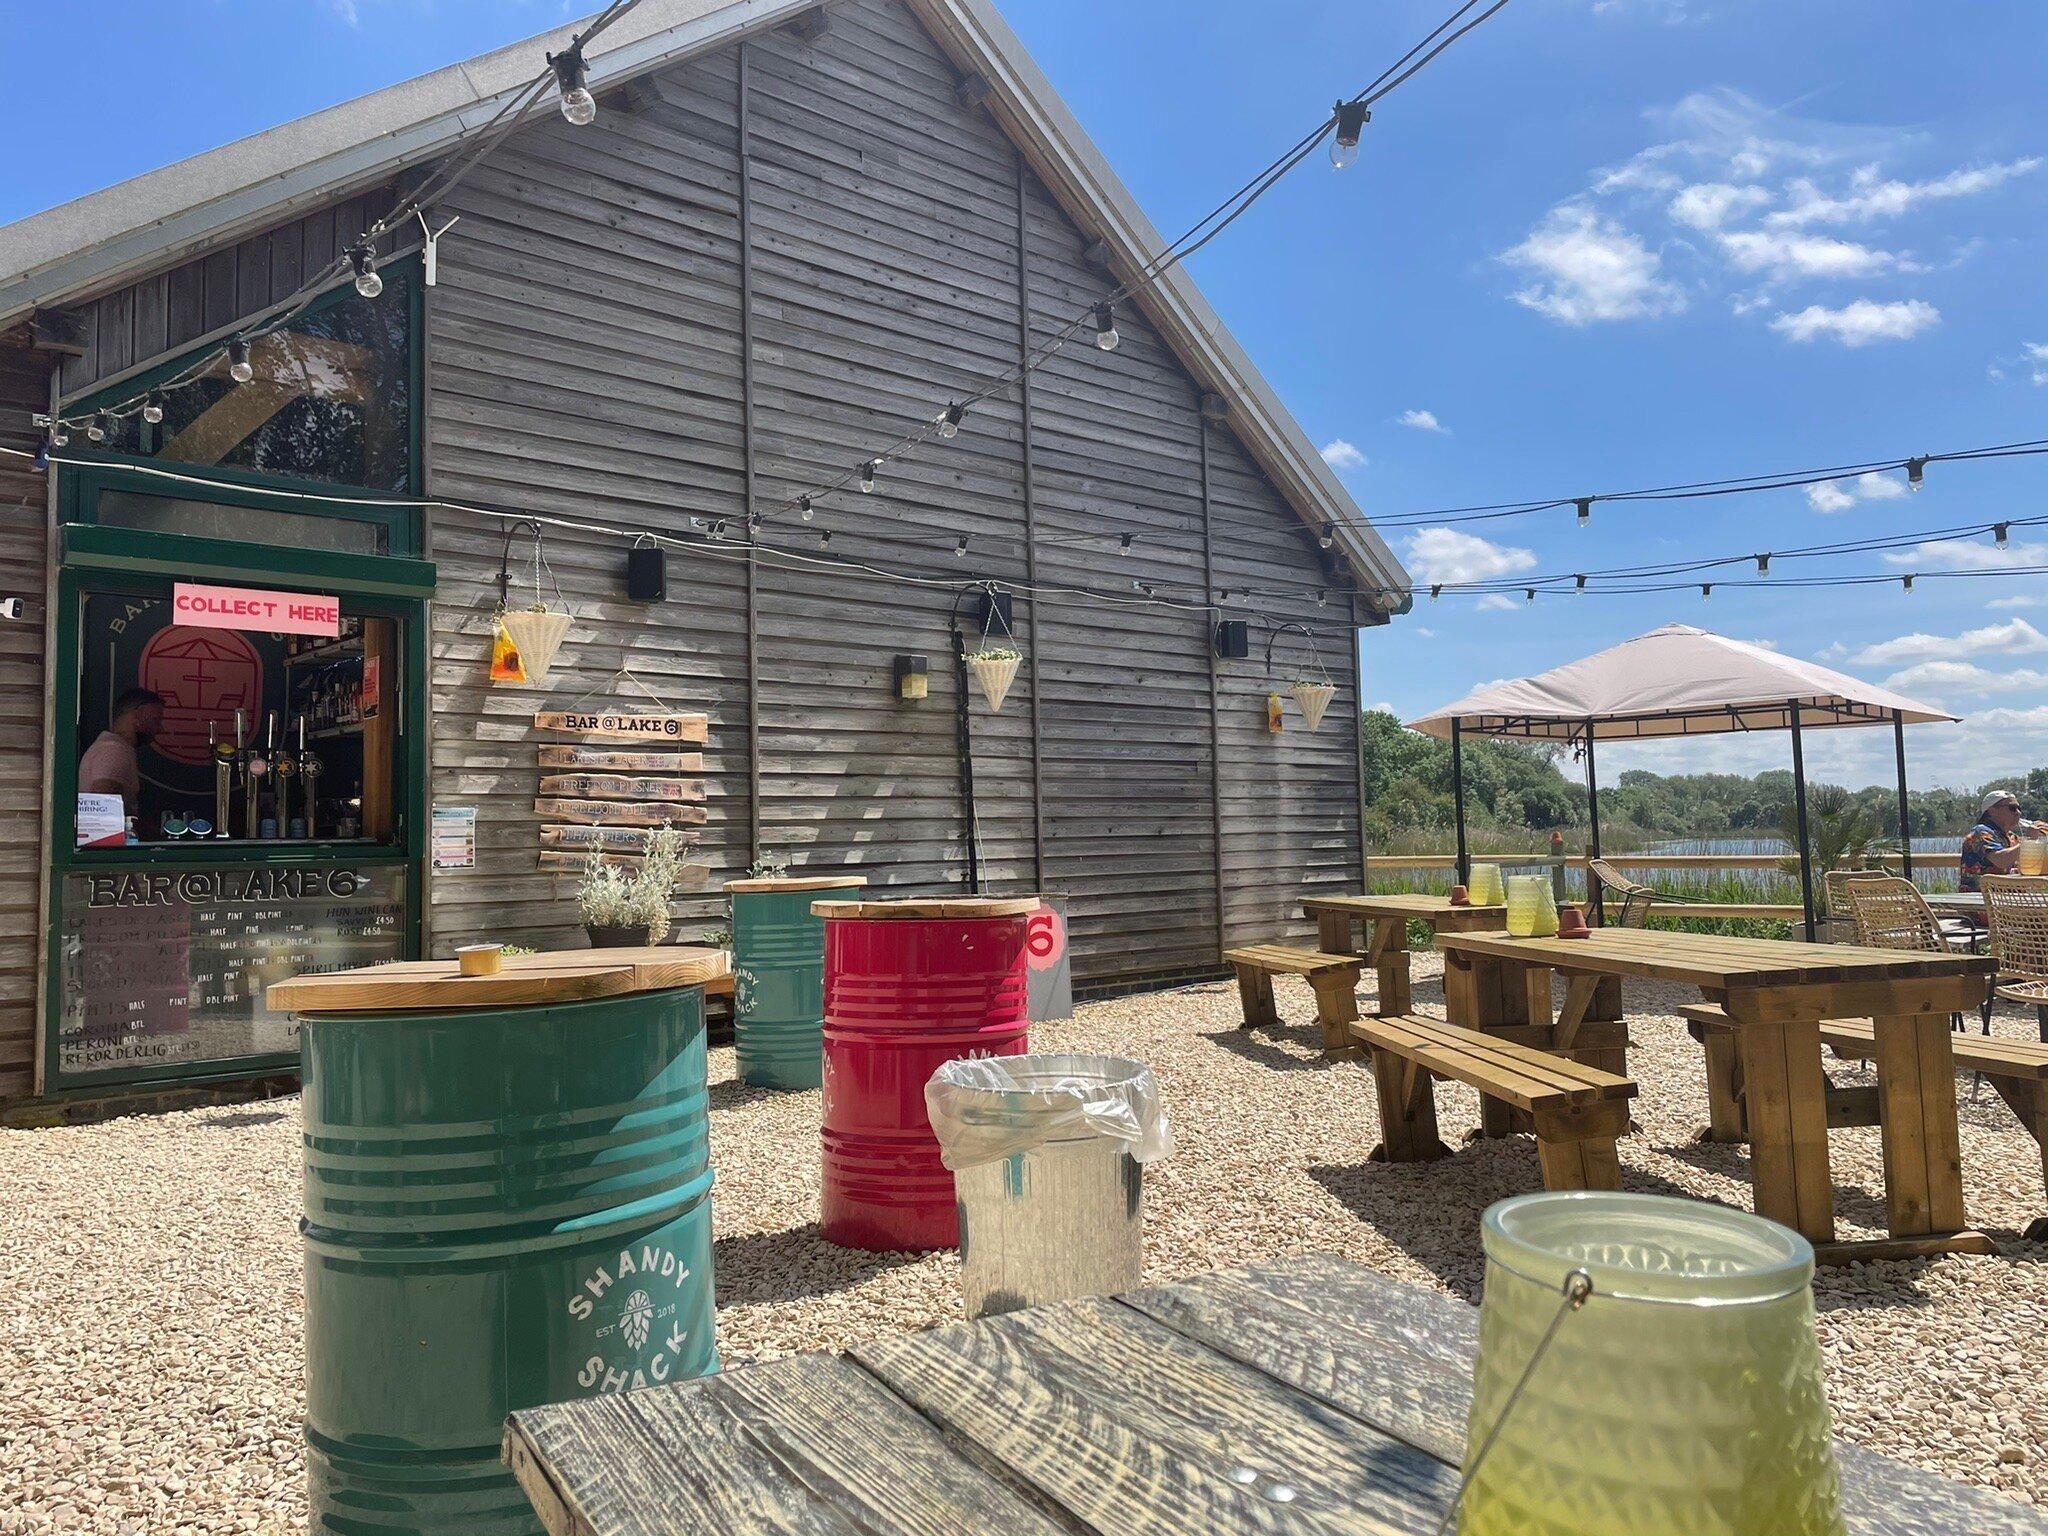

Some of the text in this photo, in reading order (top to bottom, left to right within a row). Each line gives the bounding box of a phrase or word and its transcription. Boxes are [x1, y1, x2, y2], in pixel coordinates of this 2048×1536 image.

[175, 594, 338, 624] COLLECT HERE
[565, 715, 679, 735] BAR @ LAKE 6
[562, 779, 615, 794] FREEDOM
[619, 781, 663, 794] PILSNER
[563, 803, 620, 816] FREEDOM
[200, 912, 217, 922] HALF
[227, 912, 243, 921] PINT
[267, 911, 282, 919] PINT
[210, 927, 227, 937] HALF
[245, 925, 260, 935] PINT
[1029, 915, 1054, 957] 6
[220, 941, 237, 951] HALF
[229, 958, 244, 968] HALF
[252, 957, 266, 966] PINT
[290, 954, 305, 963] PINT
[197, 973, 214, 983] HALF
[224, 971, 239, 981] PINT
[129, 999, 146, 1012] HALF
[169, 997, 188, 1007] PINT
[206, 996, 220, 1005] DBL
[222, 994, 239, 1004] PINT
[65, 1021, 131, 1037] CORONA
[65, 1035, 123, 1051] PERONI
[568, 1245, 691, 1321] SHANDY
[595, 1303, 676, 1339] EST 2018
[577, 1319, 688, 1393] SHACK
